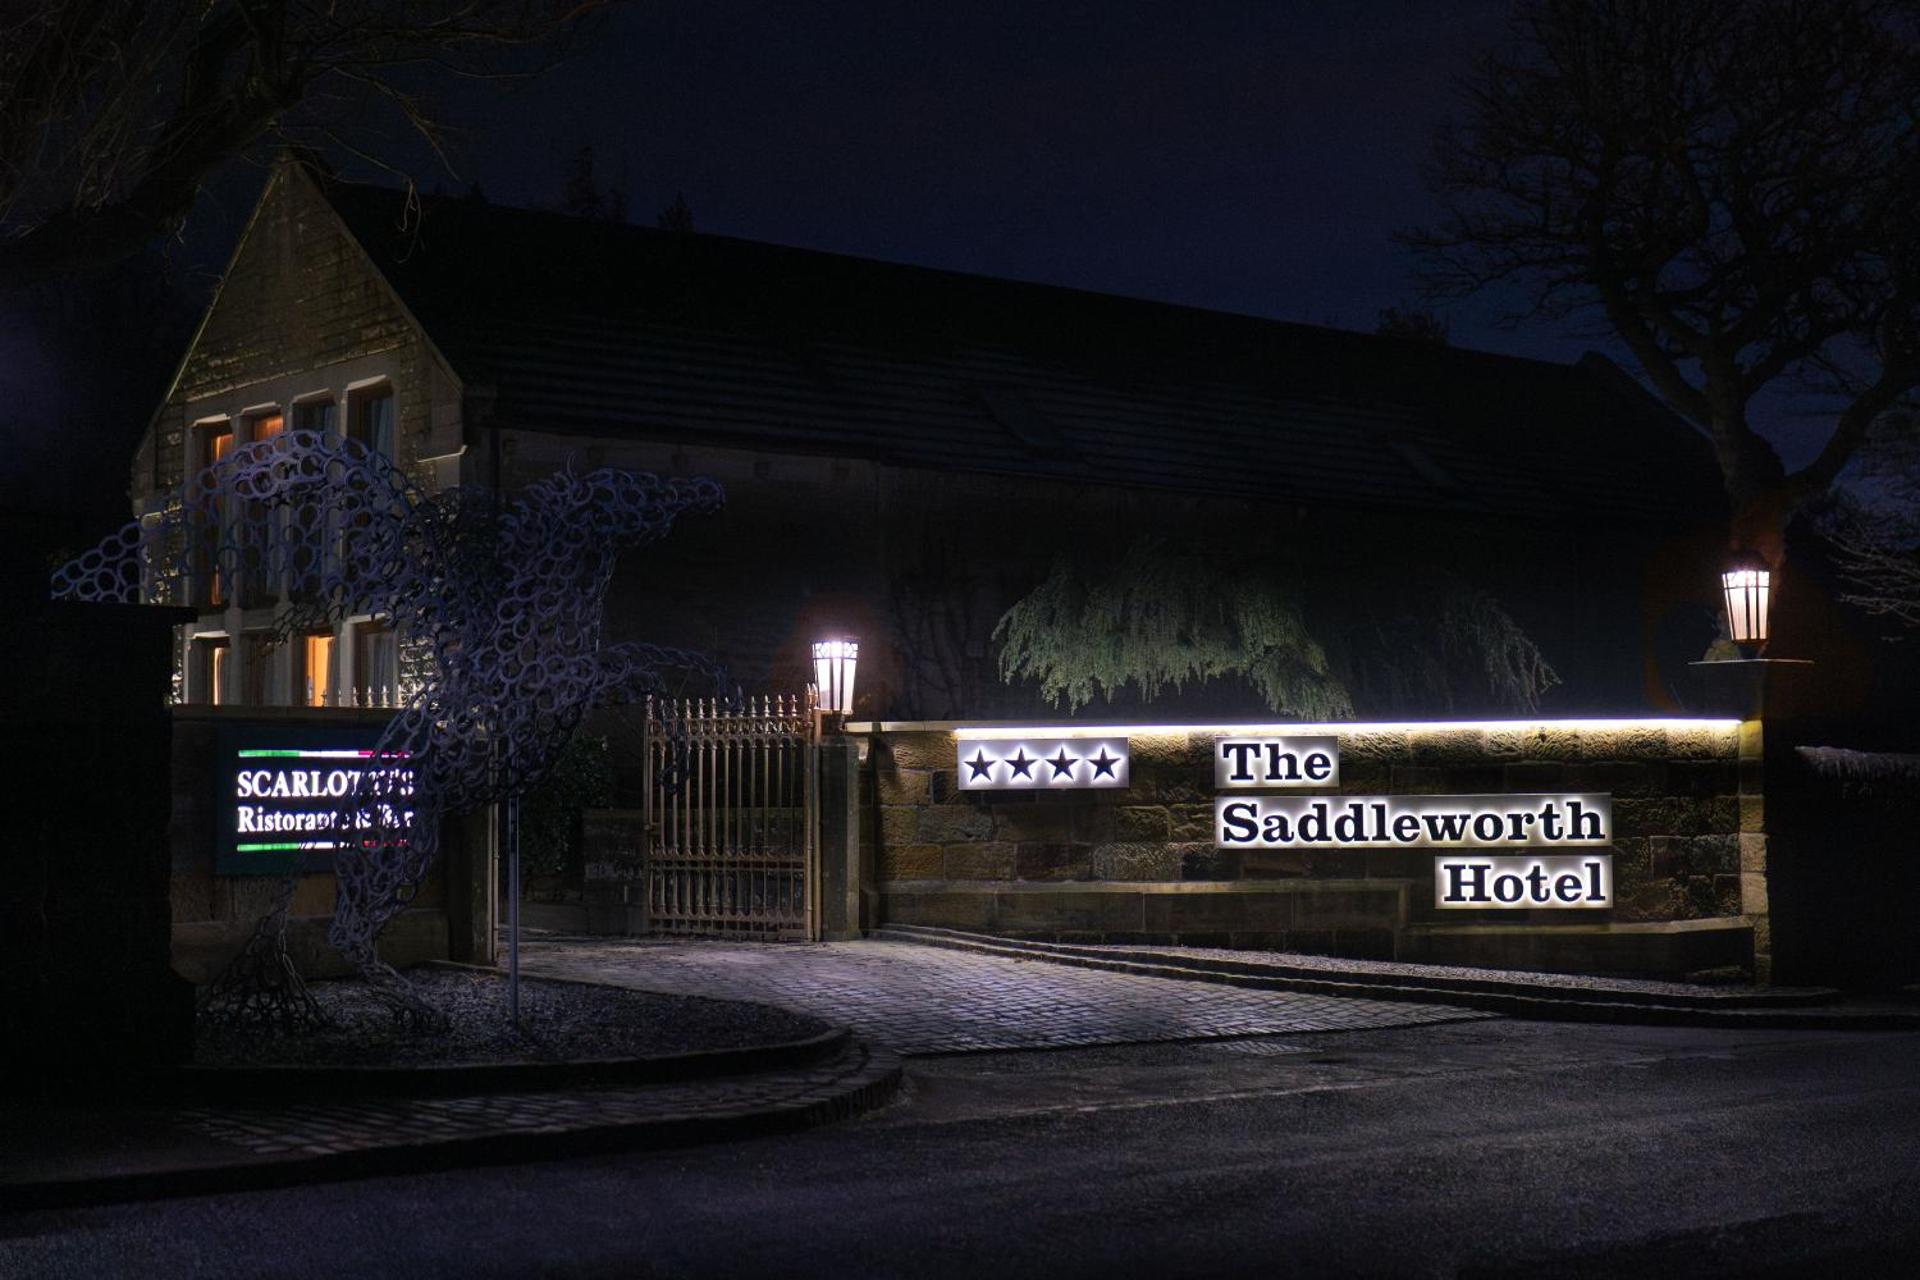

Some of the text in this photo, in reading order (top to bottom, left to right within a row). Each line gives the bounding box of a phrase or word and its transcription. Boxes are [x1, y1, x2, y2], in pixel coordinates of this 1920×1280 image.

[1223, 743, 1332, 780] The
[1223, 802, 1606, 843] Saddleworth
[1443, 862, 1606, 903] Hotel
